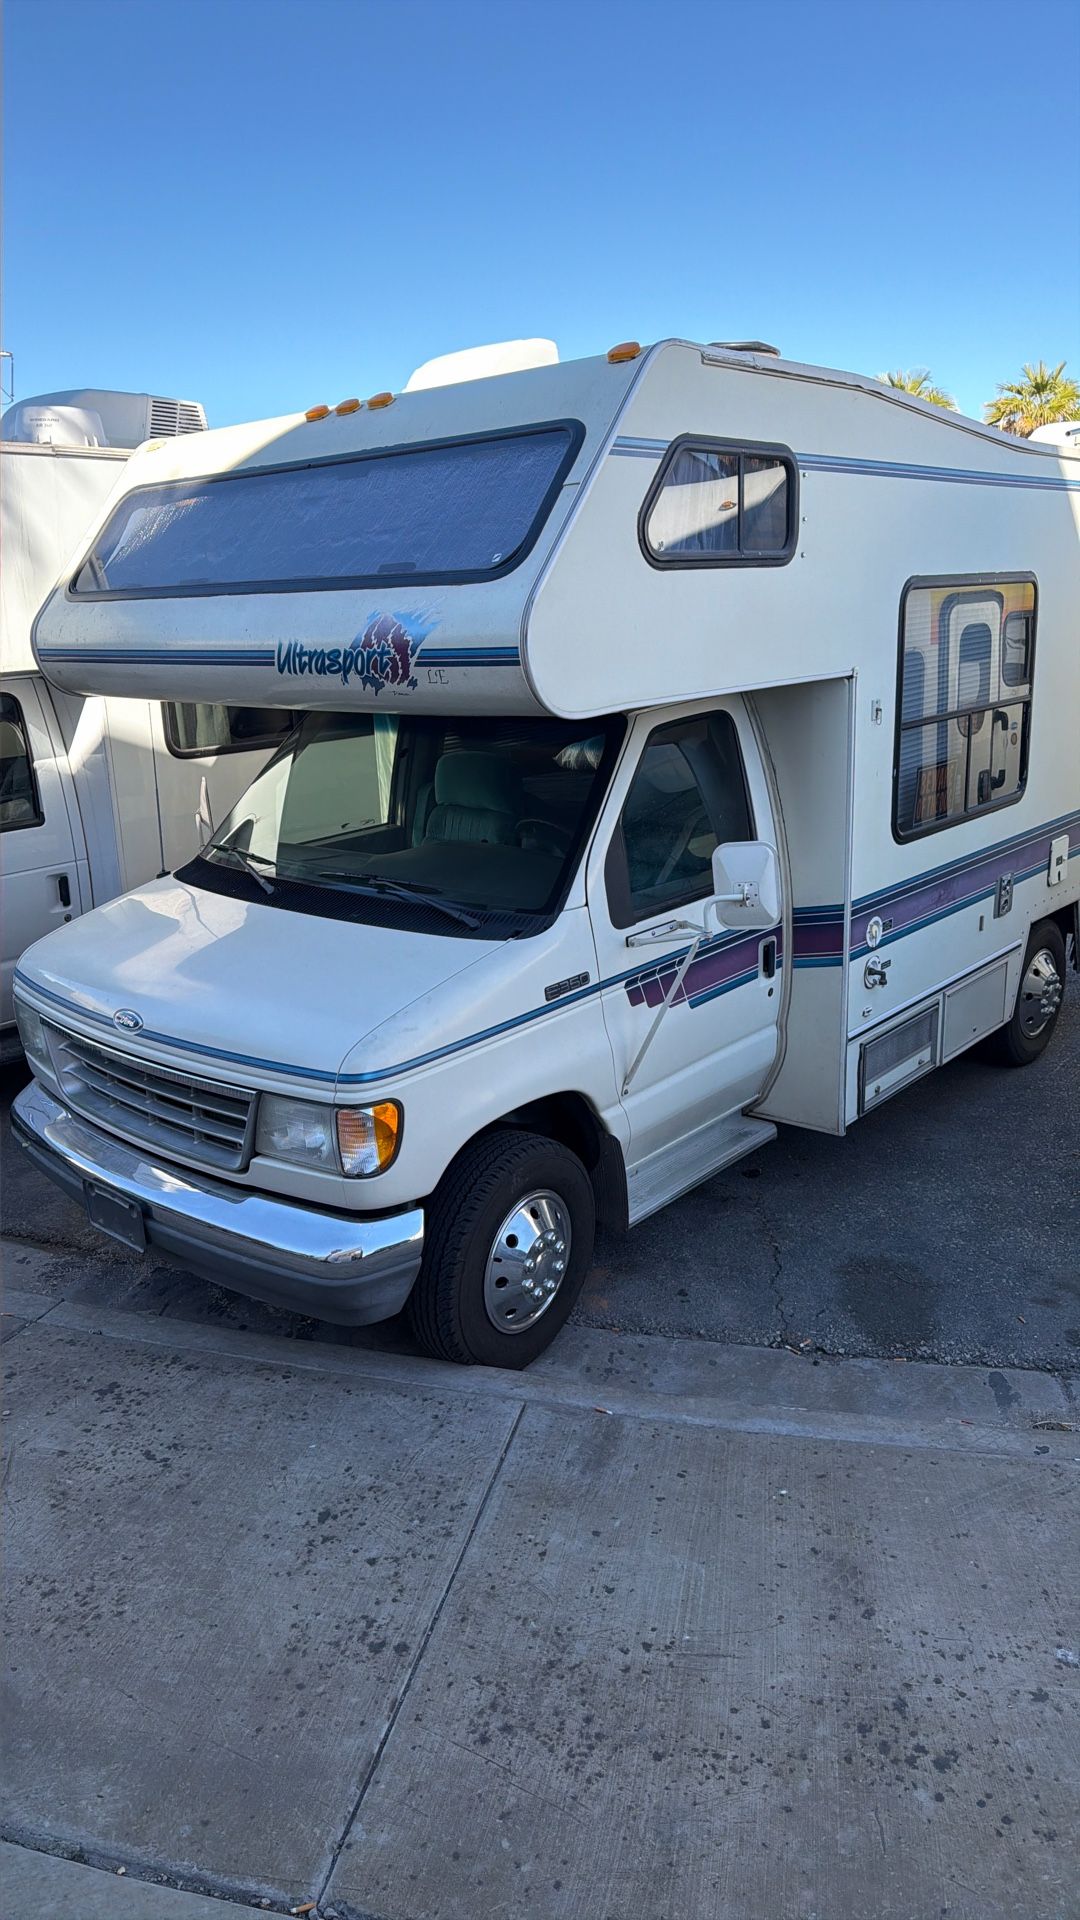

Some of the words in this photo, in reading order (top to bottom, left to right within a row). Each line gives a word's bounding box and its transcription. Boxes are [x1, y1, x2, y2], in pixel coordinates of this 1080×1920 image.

[277, 639, 392, 686] Ultrasport
[427, 669, 450, 685] LE
[545, 972, 590, 1001] E350
